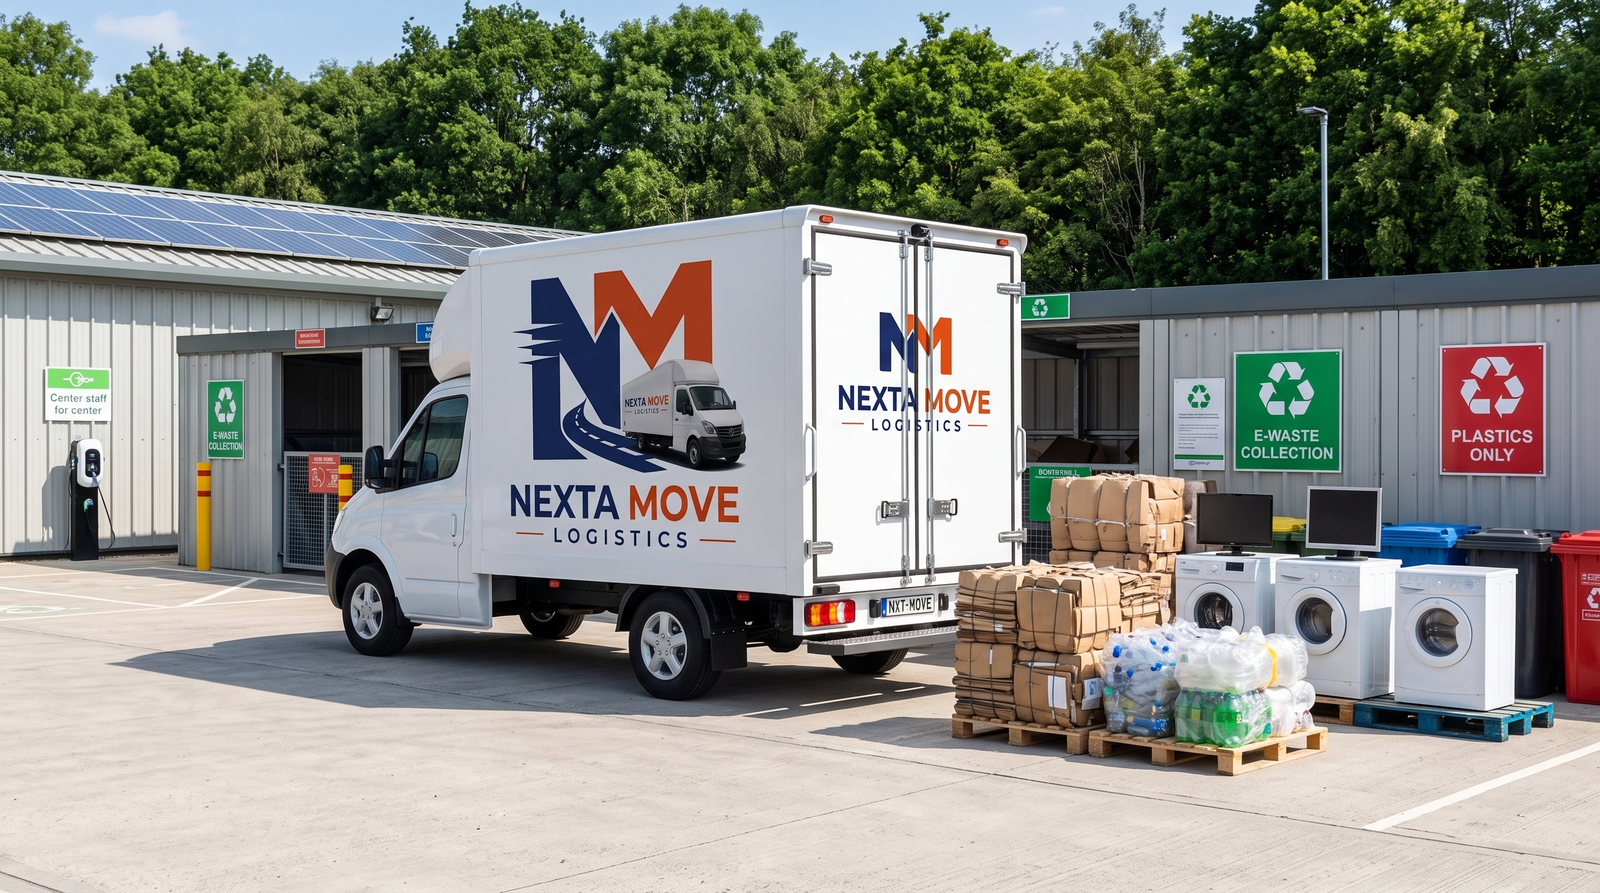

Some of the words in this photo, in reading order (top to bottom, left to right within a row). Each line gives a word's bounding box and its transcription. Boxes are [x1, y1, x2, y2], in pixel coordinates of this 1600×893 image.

[50, 393, 83, 402] Center
[86, 394, 107, 402] staff
[625, 397, 646, 407] NEXTA
[647, 395, 669, 406] MOVE
[838, 385, 918, 412] NEXTA
[925, 388, 991, 414] MOVE
[55, 405, 68, 414] for
[872, 418, 961, 432] LOGISTICS
[213, 431, 239, 440] E-WASTE
[1254, 429, 1320, 442] E-WASTE
[1452, 429, 1533, 443] PLASTICS
[208, 442, 243, 451] COLLECTION
[1241, 446, 1333, 460] COLLECTION
[1470, 447, 1515, 462] ONLY
[510, 484, 620, 520] NEXTA
[629, 484, 740, 523] MOVE
[554, 527, 688, 549] LOGISTICS
[888, 597, 932, 614] NXT-MOVE
